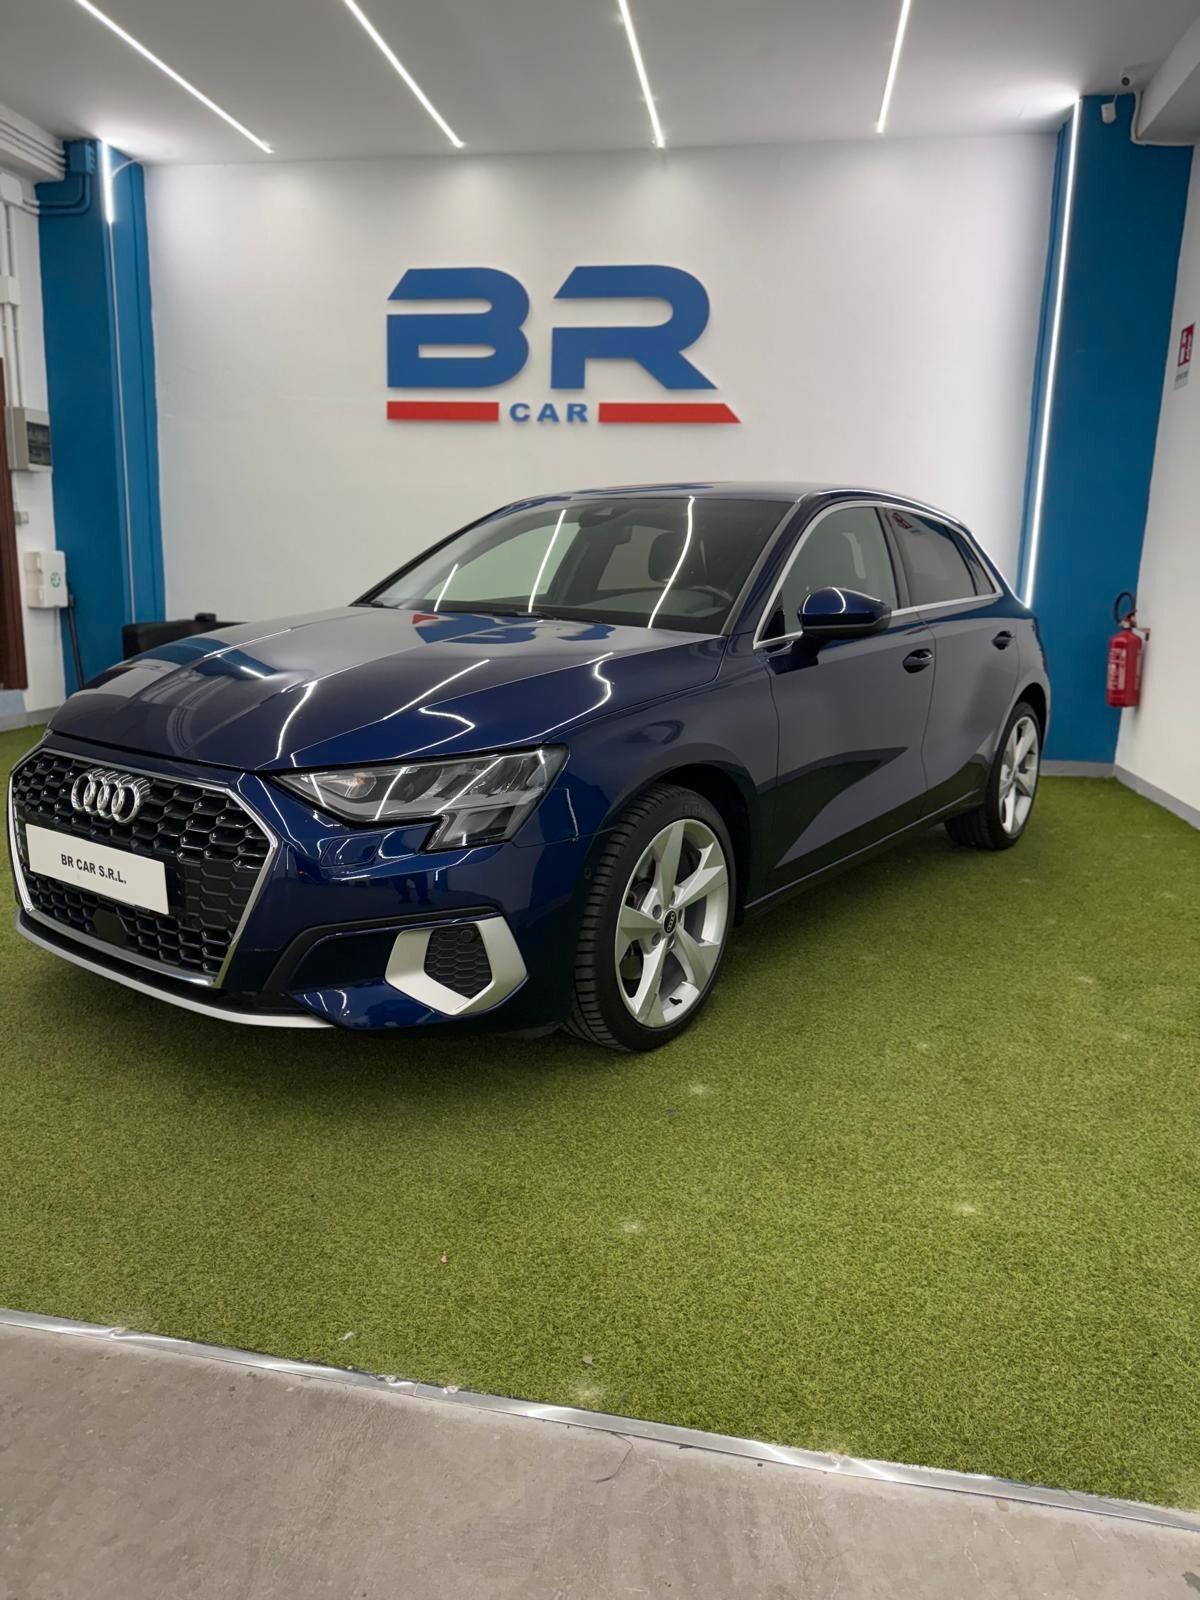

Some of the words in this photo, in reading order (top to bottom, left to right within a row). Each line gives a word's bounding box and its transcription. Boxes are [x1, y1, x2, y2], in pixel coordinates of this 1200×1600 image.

[387, 264, 718, 390] BR
[509, 402, 589, 424] CAR
[61, 853, 74, 868] BR
[76, 858, 96, 874] CAR
[98, 865, 127, 884] S.R.L.
